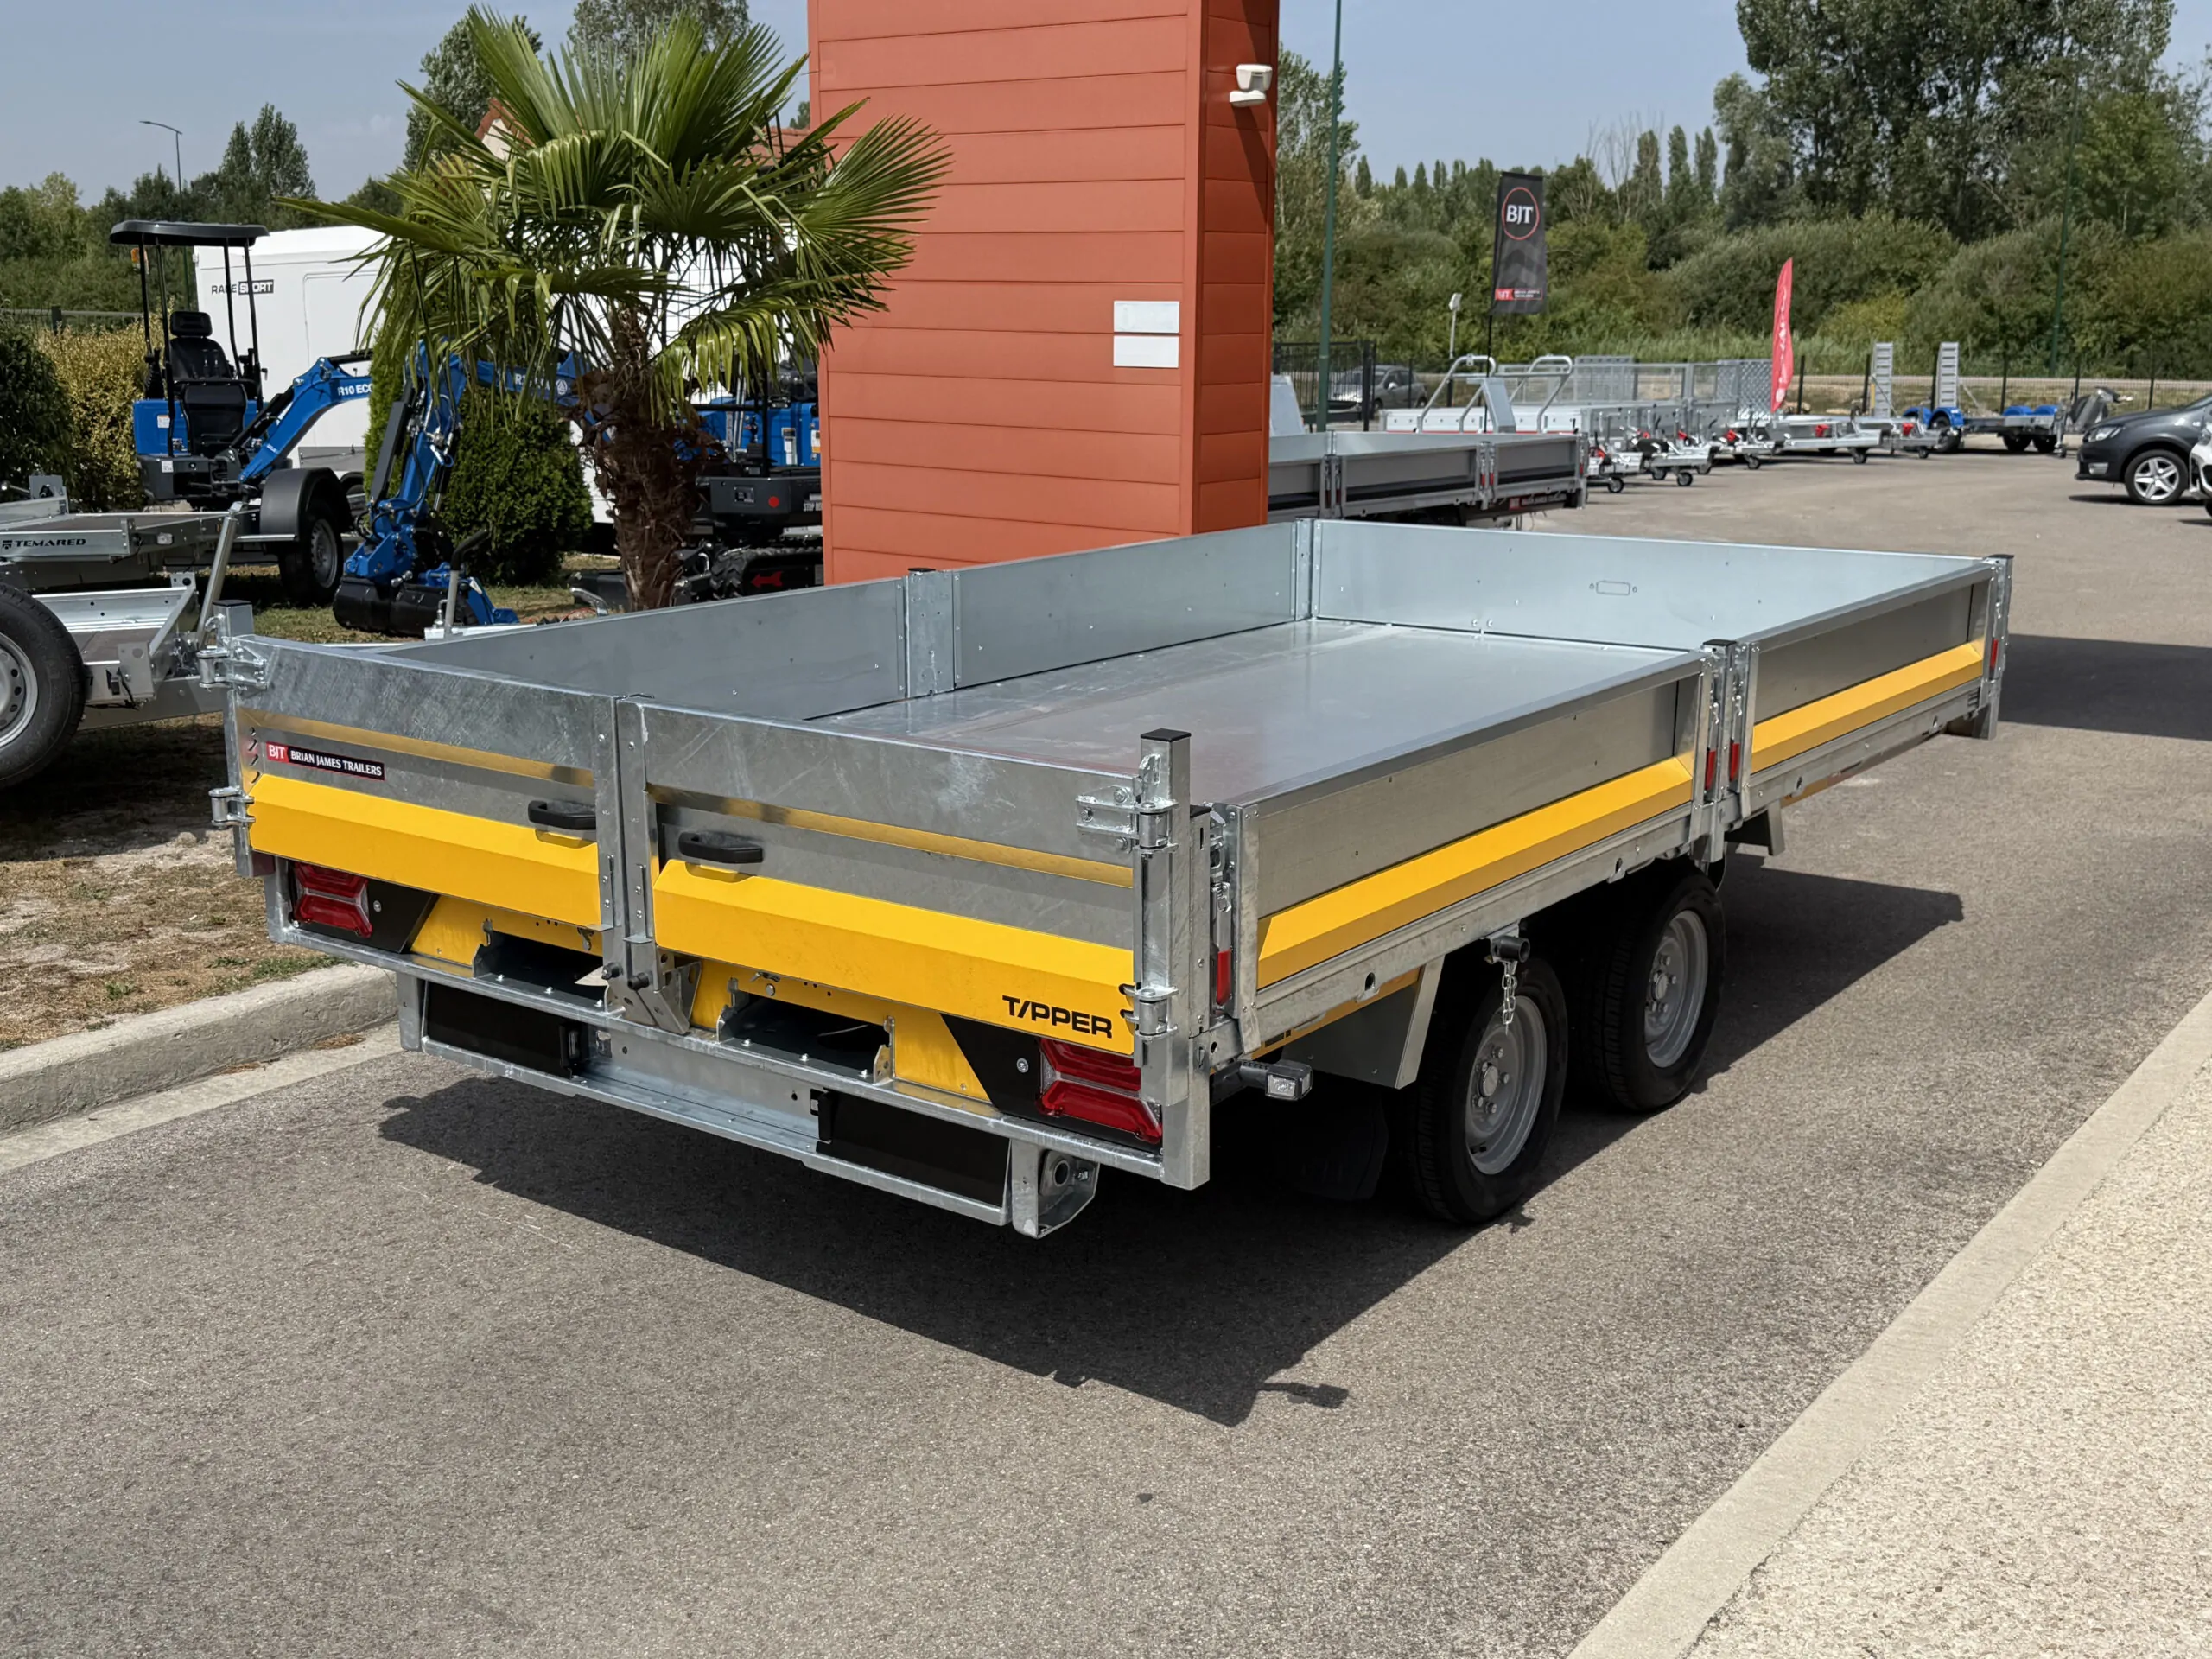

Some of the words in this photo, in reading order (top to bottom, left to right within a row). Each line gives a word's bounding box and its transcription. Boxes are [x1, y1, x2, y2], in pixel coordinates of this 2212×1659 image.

[211, 283, 238, 295] RAE
[239, 282, 273, 294] SORT
[337, 385, 355, 397] R10
[15, 538, 86, 548] TEMARED
[290, 750, 315, 765] BRIAN
[316, 755, 341, 769] JAMES
[342, 760, 382, 776] TRAILERS
